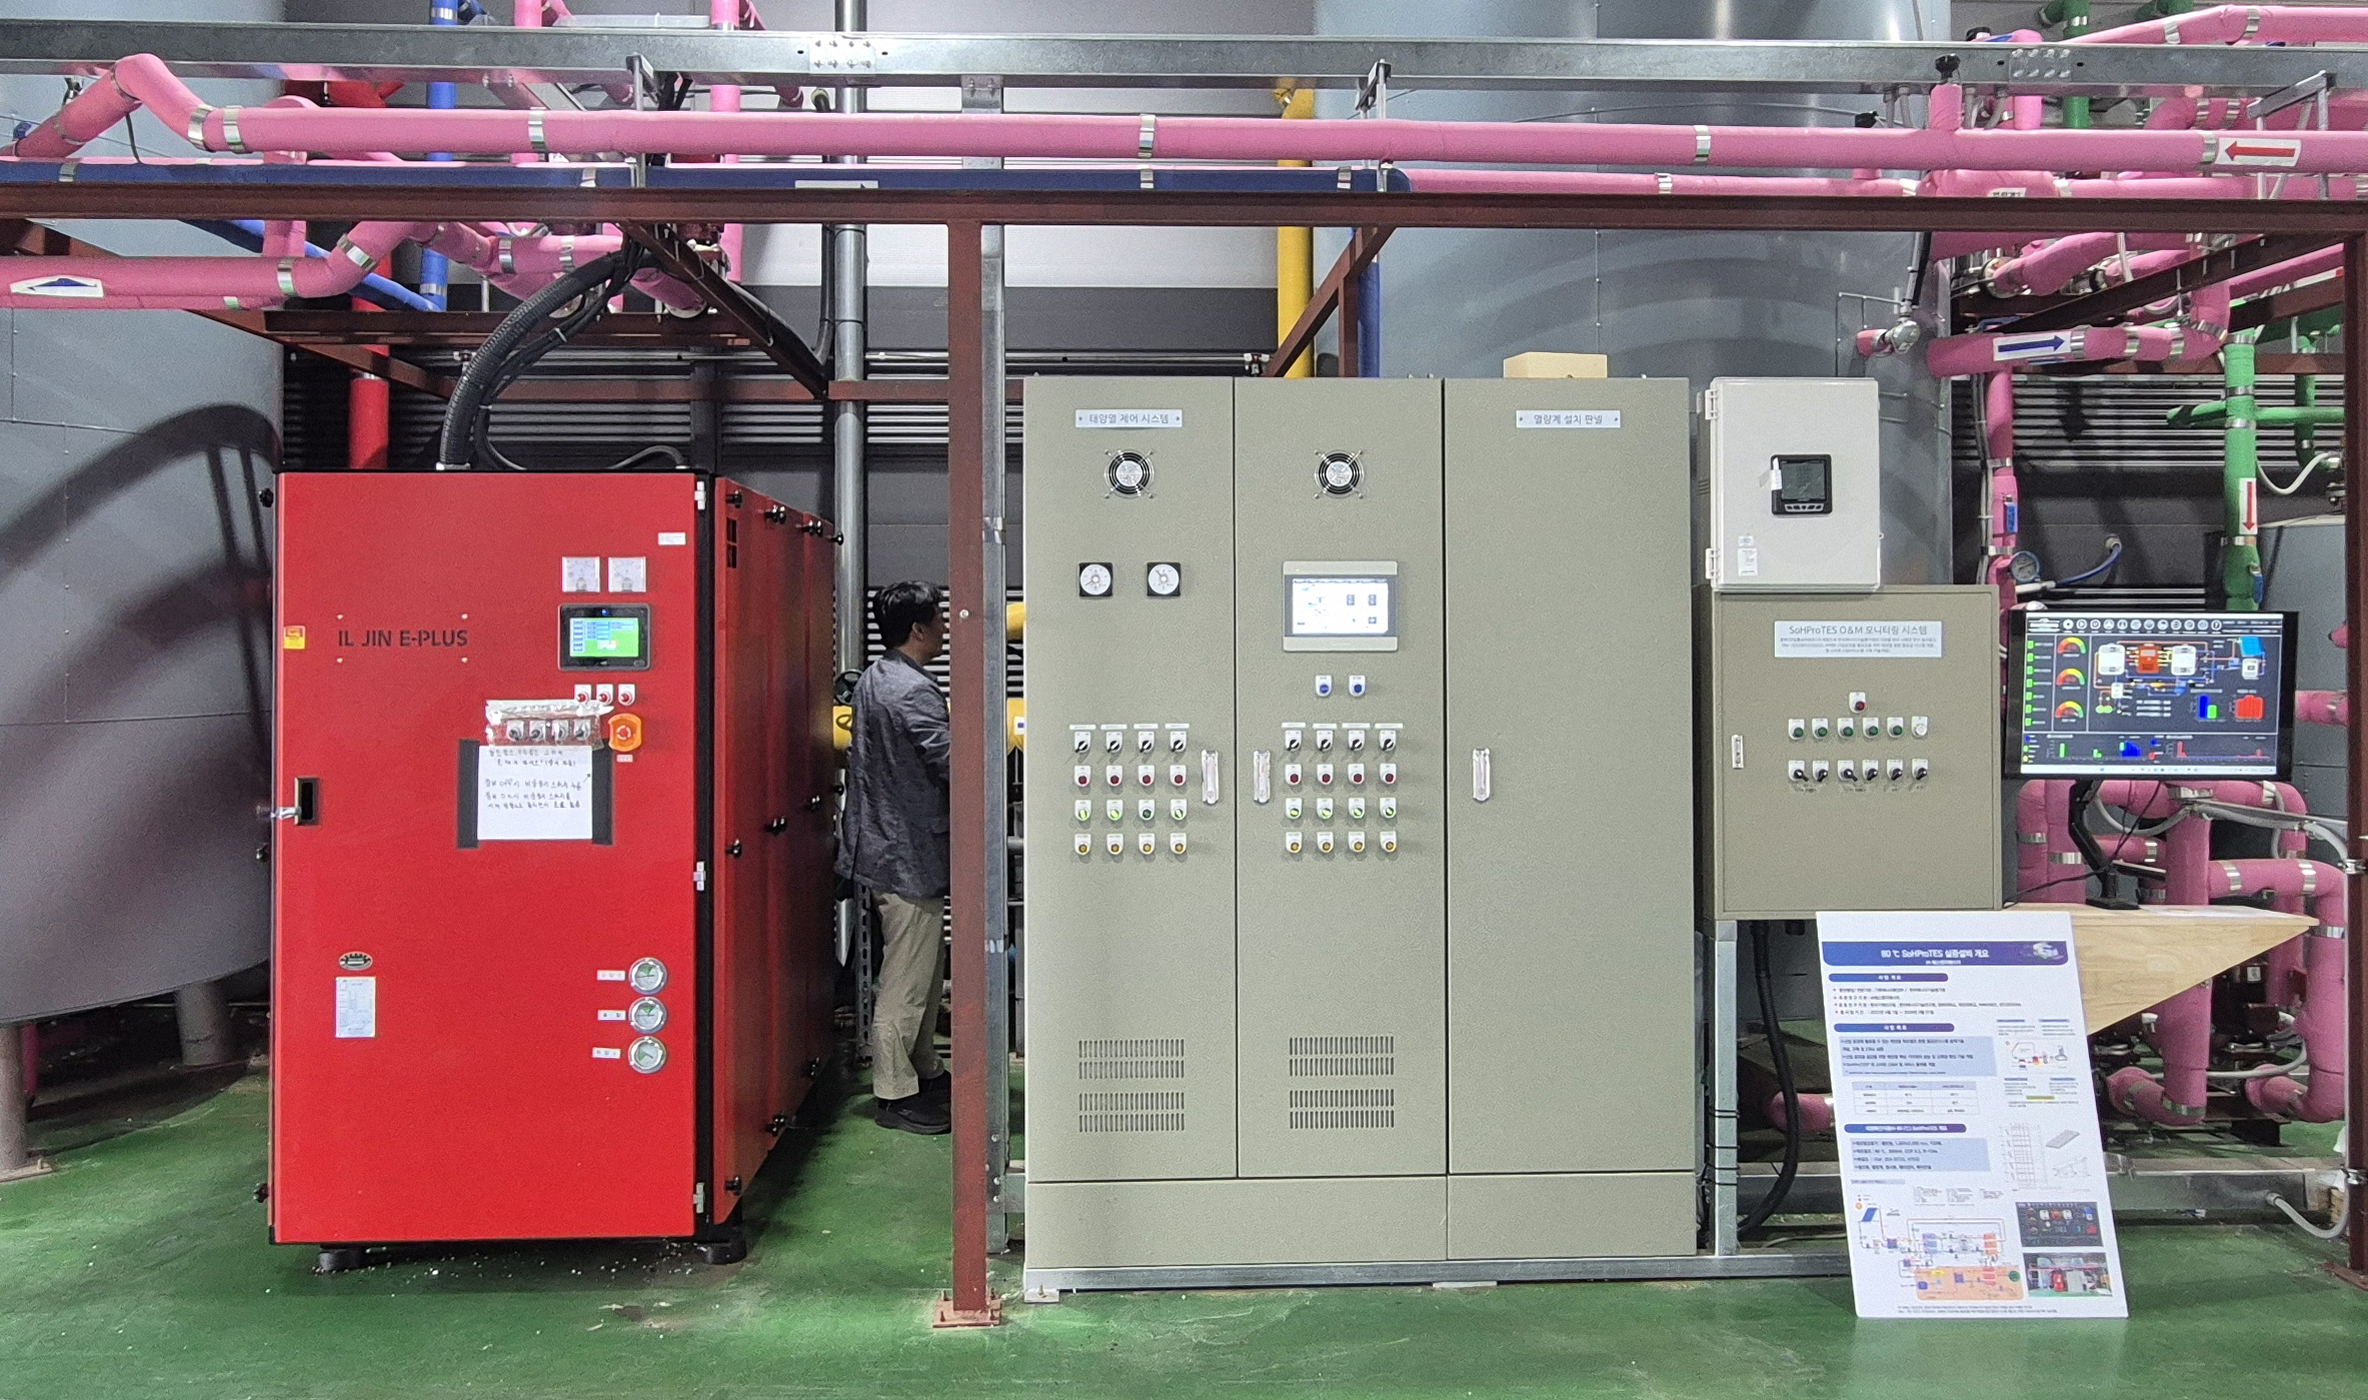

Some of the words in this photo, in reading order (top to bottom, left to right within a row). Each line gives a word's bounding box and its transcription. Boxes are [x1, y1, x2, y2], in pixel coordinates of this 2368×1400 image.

[1089, 413, 1117, 424] 태양열
[1120, 413, 1139, 424] 제어
[1141, 413, 1169, 424] 시스템
[1533, 414, 1561, 425] 열량계
[1564, 414, 1582, 425] 설치
[1585, 414, 1603, 425] 판넬
[1789, 625, 1837, 635] SoHProTES
[1839, 625, 1863, 635] O&M
[1865, 625, 1899, 636] 모니터링
[1902, 625, 1928, 636] 시스템
[338, 629, 355, 647] IL
[361, 629, 392, 647] JIN
[399, 629, 468, 647] E-PLUS
[1974, 949, 1989, 958] 개요
